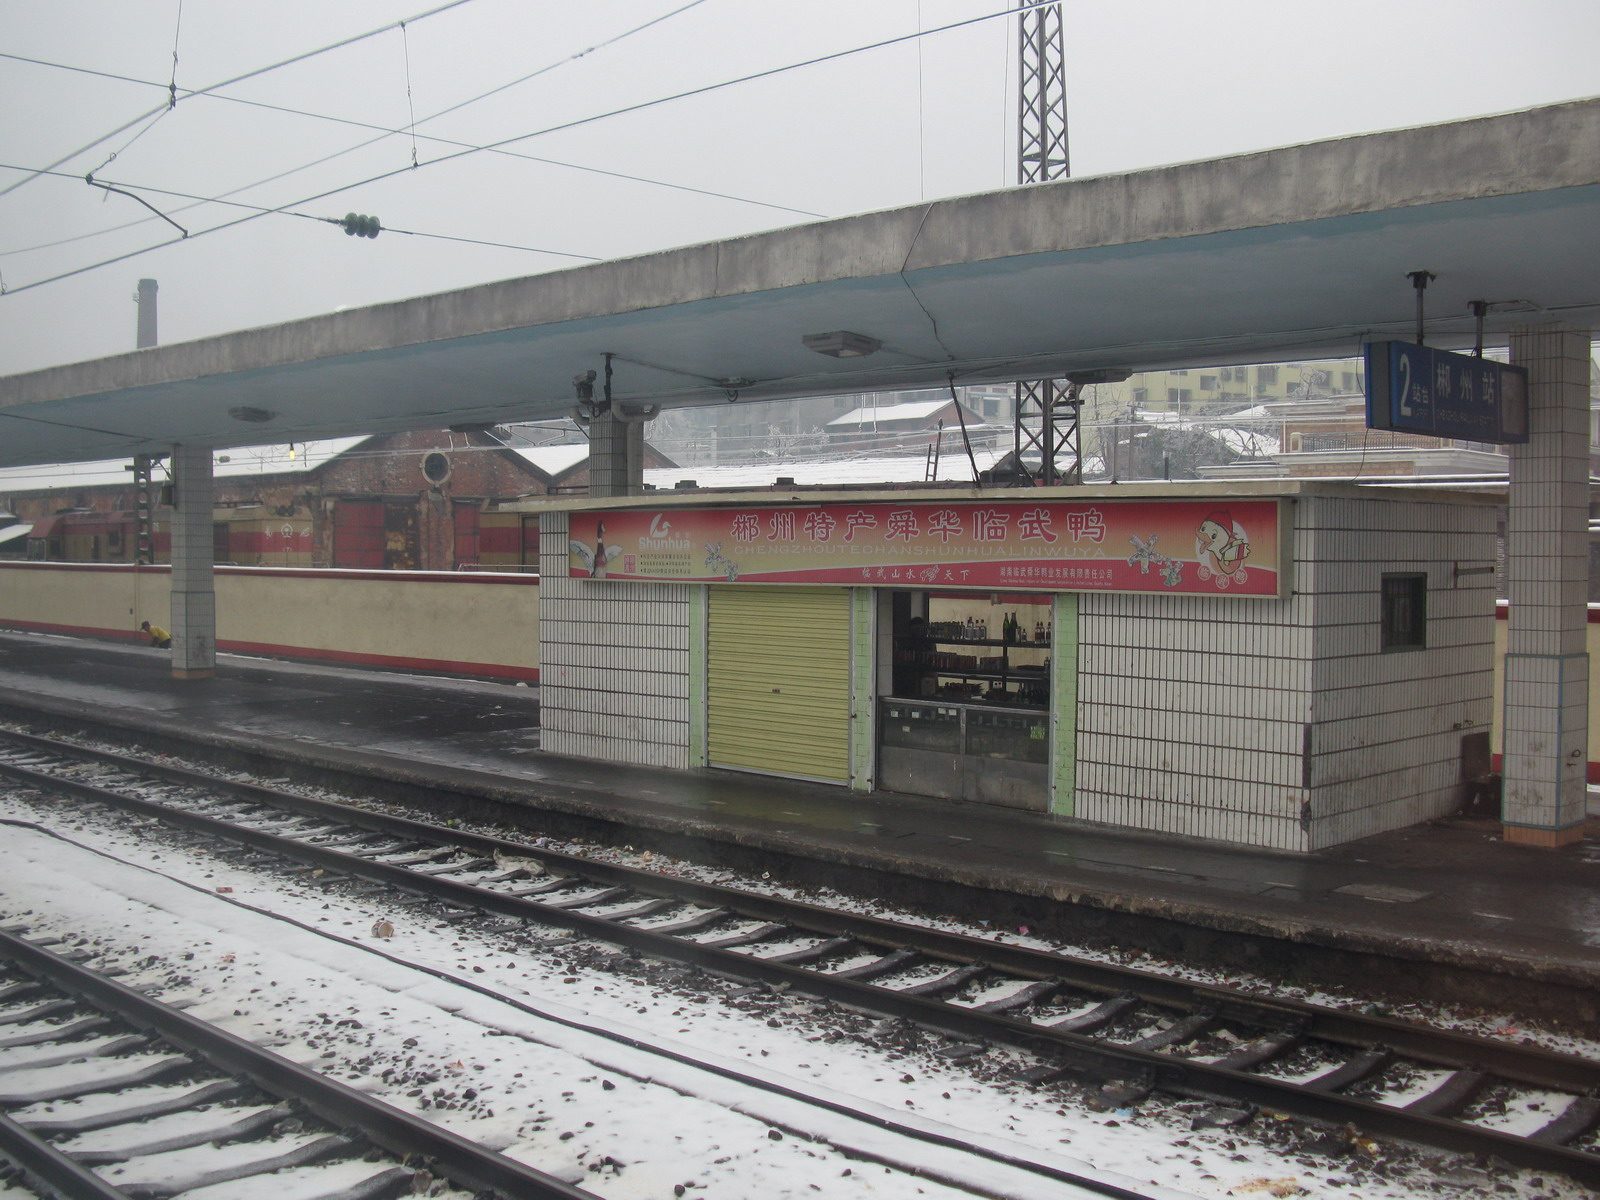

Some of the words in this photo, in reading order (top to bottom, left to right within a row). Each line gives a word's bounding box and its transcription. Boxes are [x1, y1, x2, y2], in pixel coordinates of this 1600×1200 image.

[1400, 353, 1412, 417] 2
[1436, 363, 1495, 404] 郴州站
[638, 536, 690, 550] Shunhua
[731, 508, 1106, 542] 郴州特产舜华临武鸭
